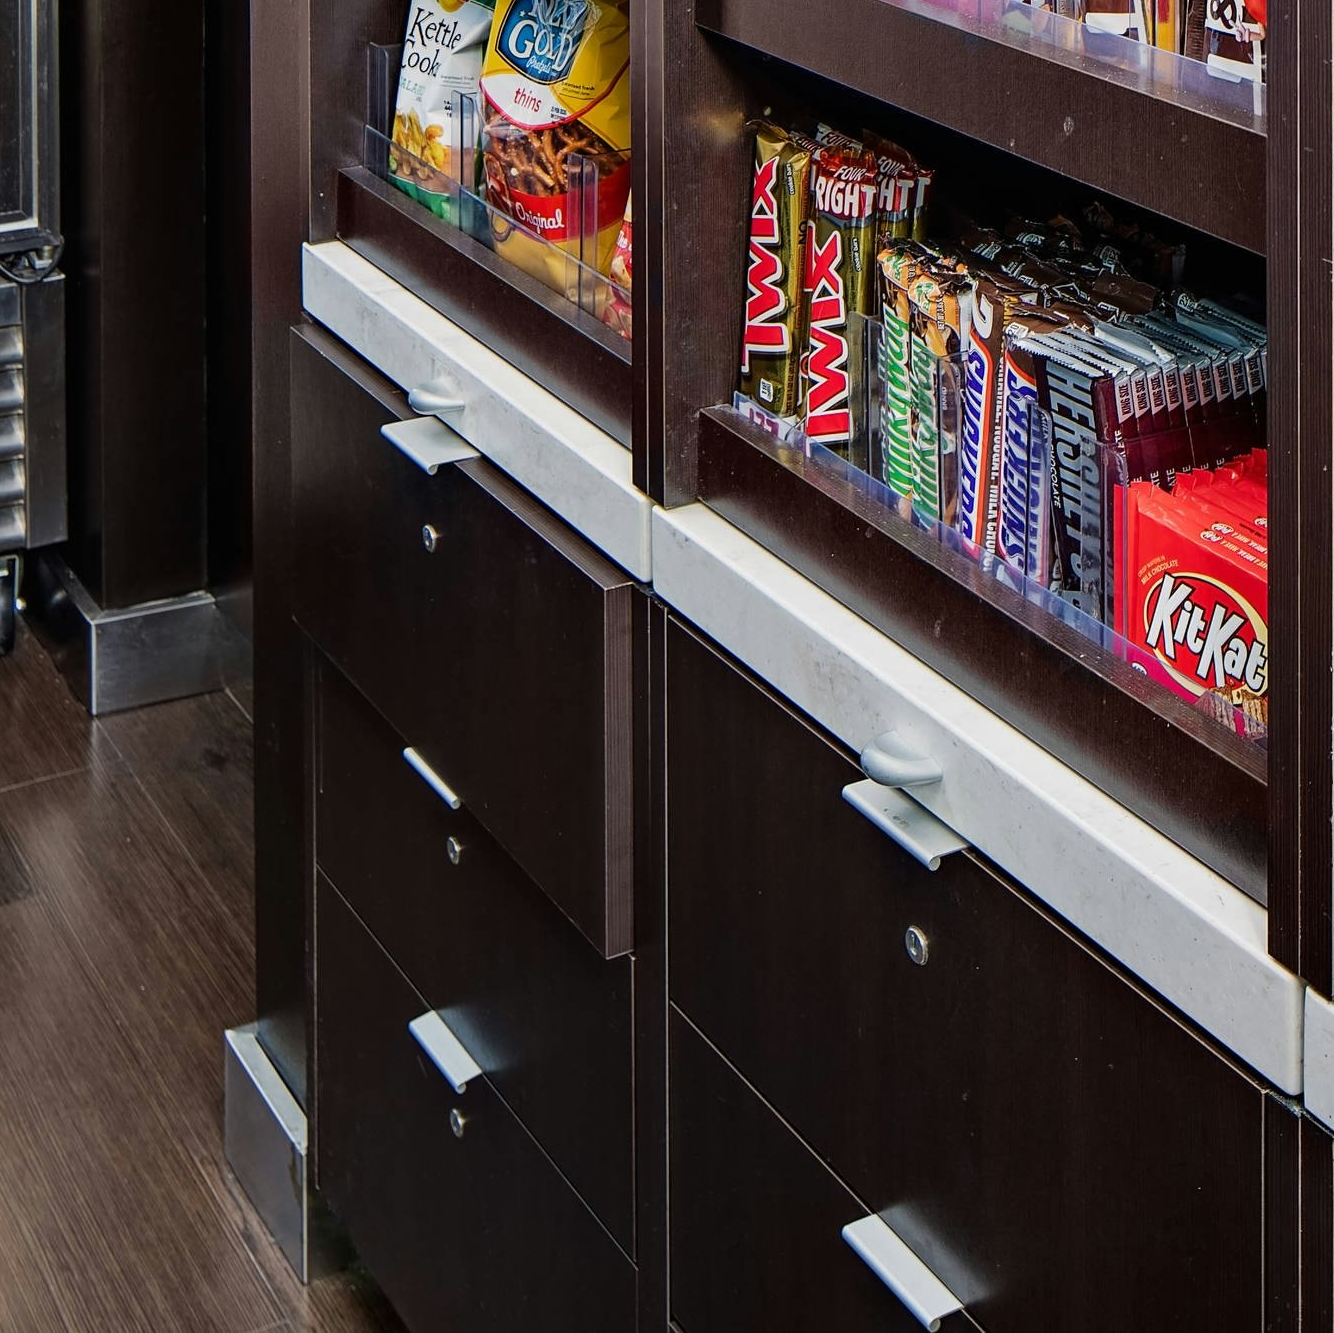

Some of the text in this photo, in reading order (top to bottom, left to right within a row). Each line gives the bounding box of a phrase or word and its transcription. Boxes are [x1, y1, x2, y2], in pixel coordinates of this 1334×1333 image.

[407, 6, 463, 50] Kettle
[507, 19, 574, 73] GOLD
[513, 86, 543, 114] thins
[832, 165, 865, 182] FOUR
[515, 201, 566, 230] Original
[815, 183, 878, 219] RIGHT
[741, 155, 791, 374] TWIX
[805, 230, 850, 458] TWIX
[1118, 382, 1132, 417] KING SIZE
[1137, 376, 1149, 411] KING SIZE
[1153, 373, 1165, 408] KING SIZE
[1168, 370, 1180, 405] KING SIZE
[1185, 368, 1197, 404] KING SIZE
